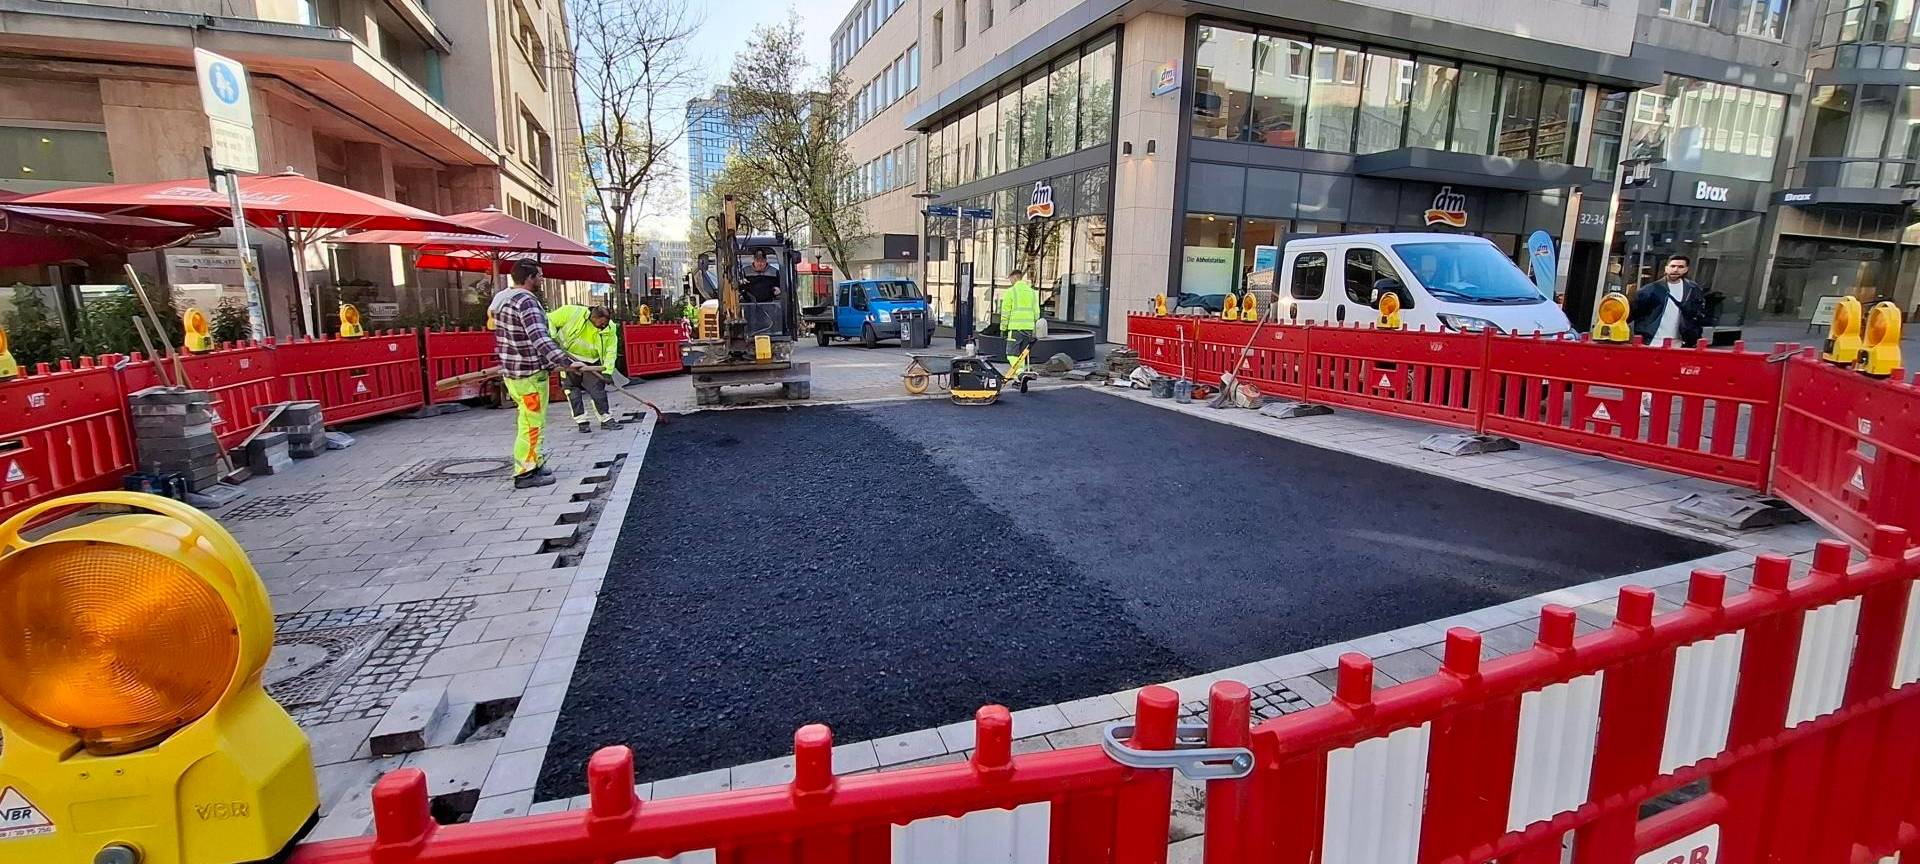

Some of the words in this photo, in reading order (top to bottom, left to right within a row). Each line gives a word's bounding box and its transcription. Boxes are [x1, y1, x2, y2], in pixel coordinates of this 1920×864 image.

[1431, 185, 1466, 212] dm
[1695, 180, 1729, 202] Brax
[1784, 193, 1811, 201] Brax
[1580, 213, 1605, 225] 32-34
[0, 805, 32, 821] VBR
[193, 801, 249, 821] VBR
